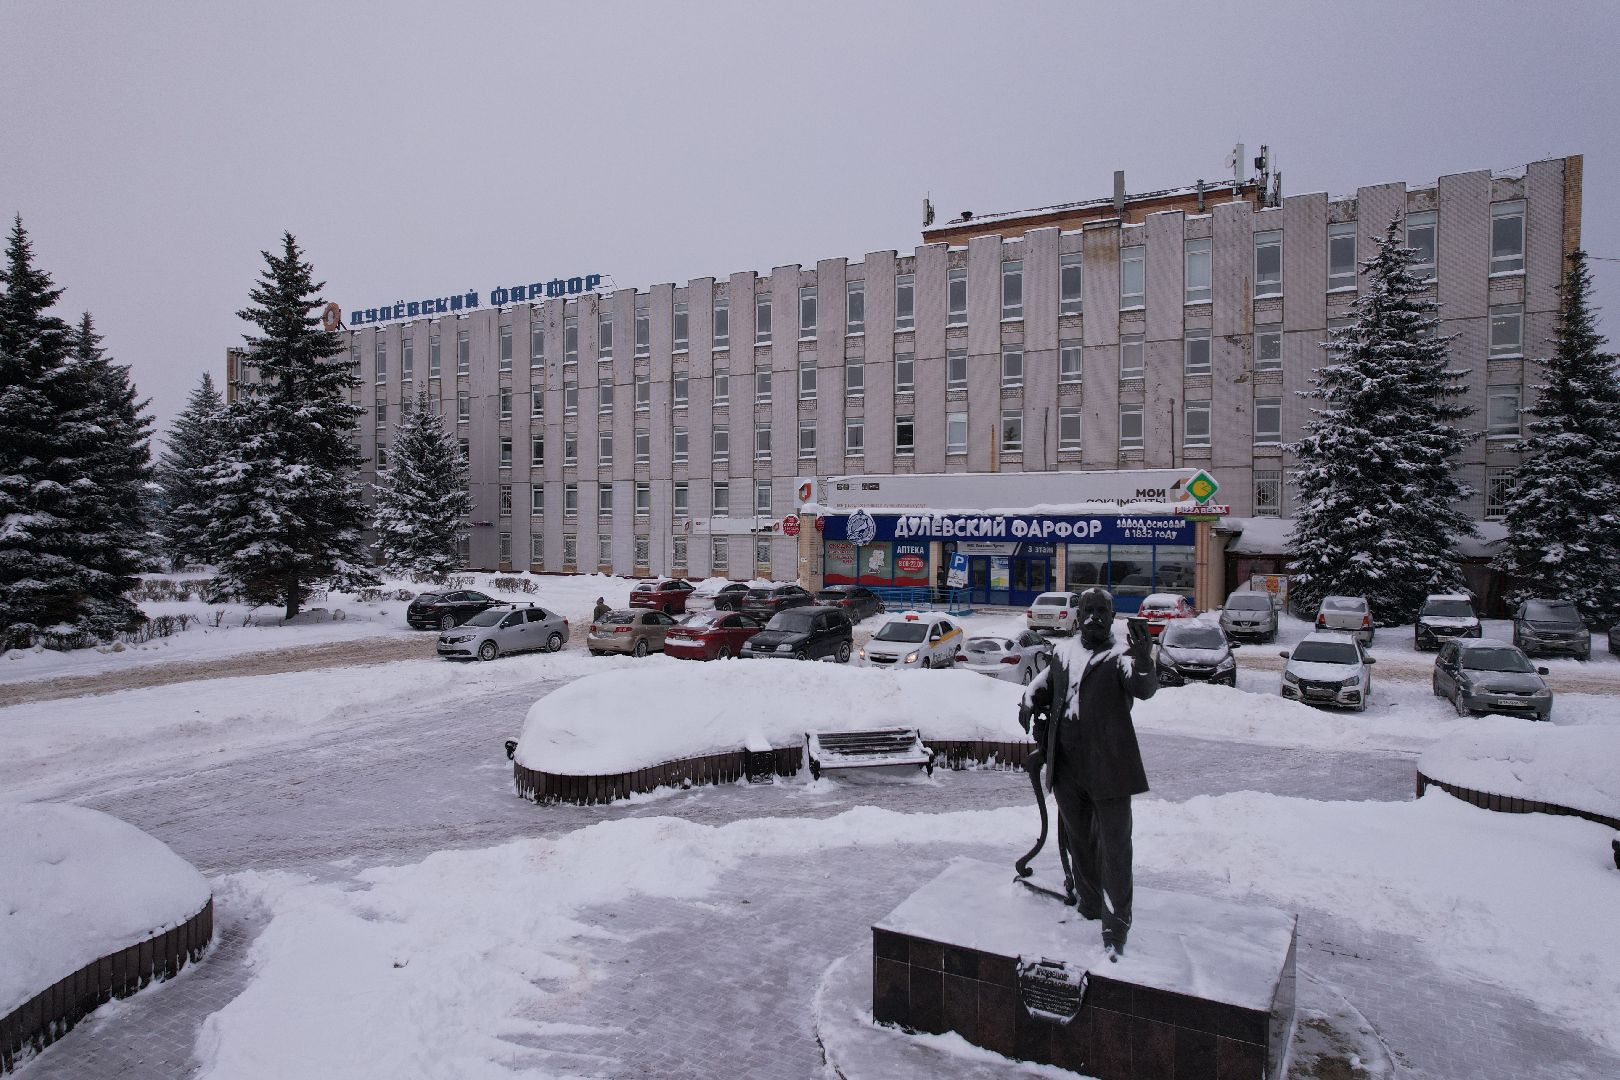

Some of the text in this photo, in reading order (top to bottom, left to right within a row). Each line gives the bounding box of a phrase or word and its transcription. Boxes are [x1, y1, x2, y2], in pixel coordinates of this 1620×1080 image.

[490, 273, 602, 307] ФАРФОР
[1136, 488, 1166, 498] МОИ
[1011, 519, 1103, 538] ФАРФОР
[1132, 529, 1153, 538] 1832
[896, 545, 925, 554] АПТЕКА
